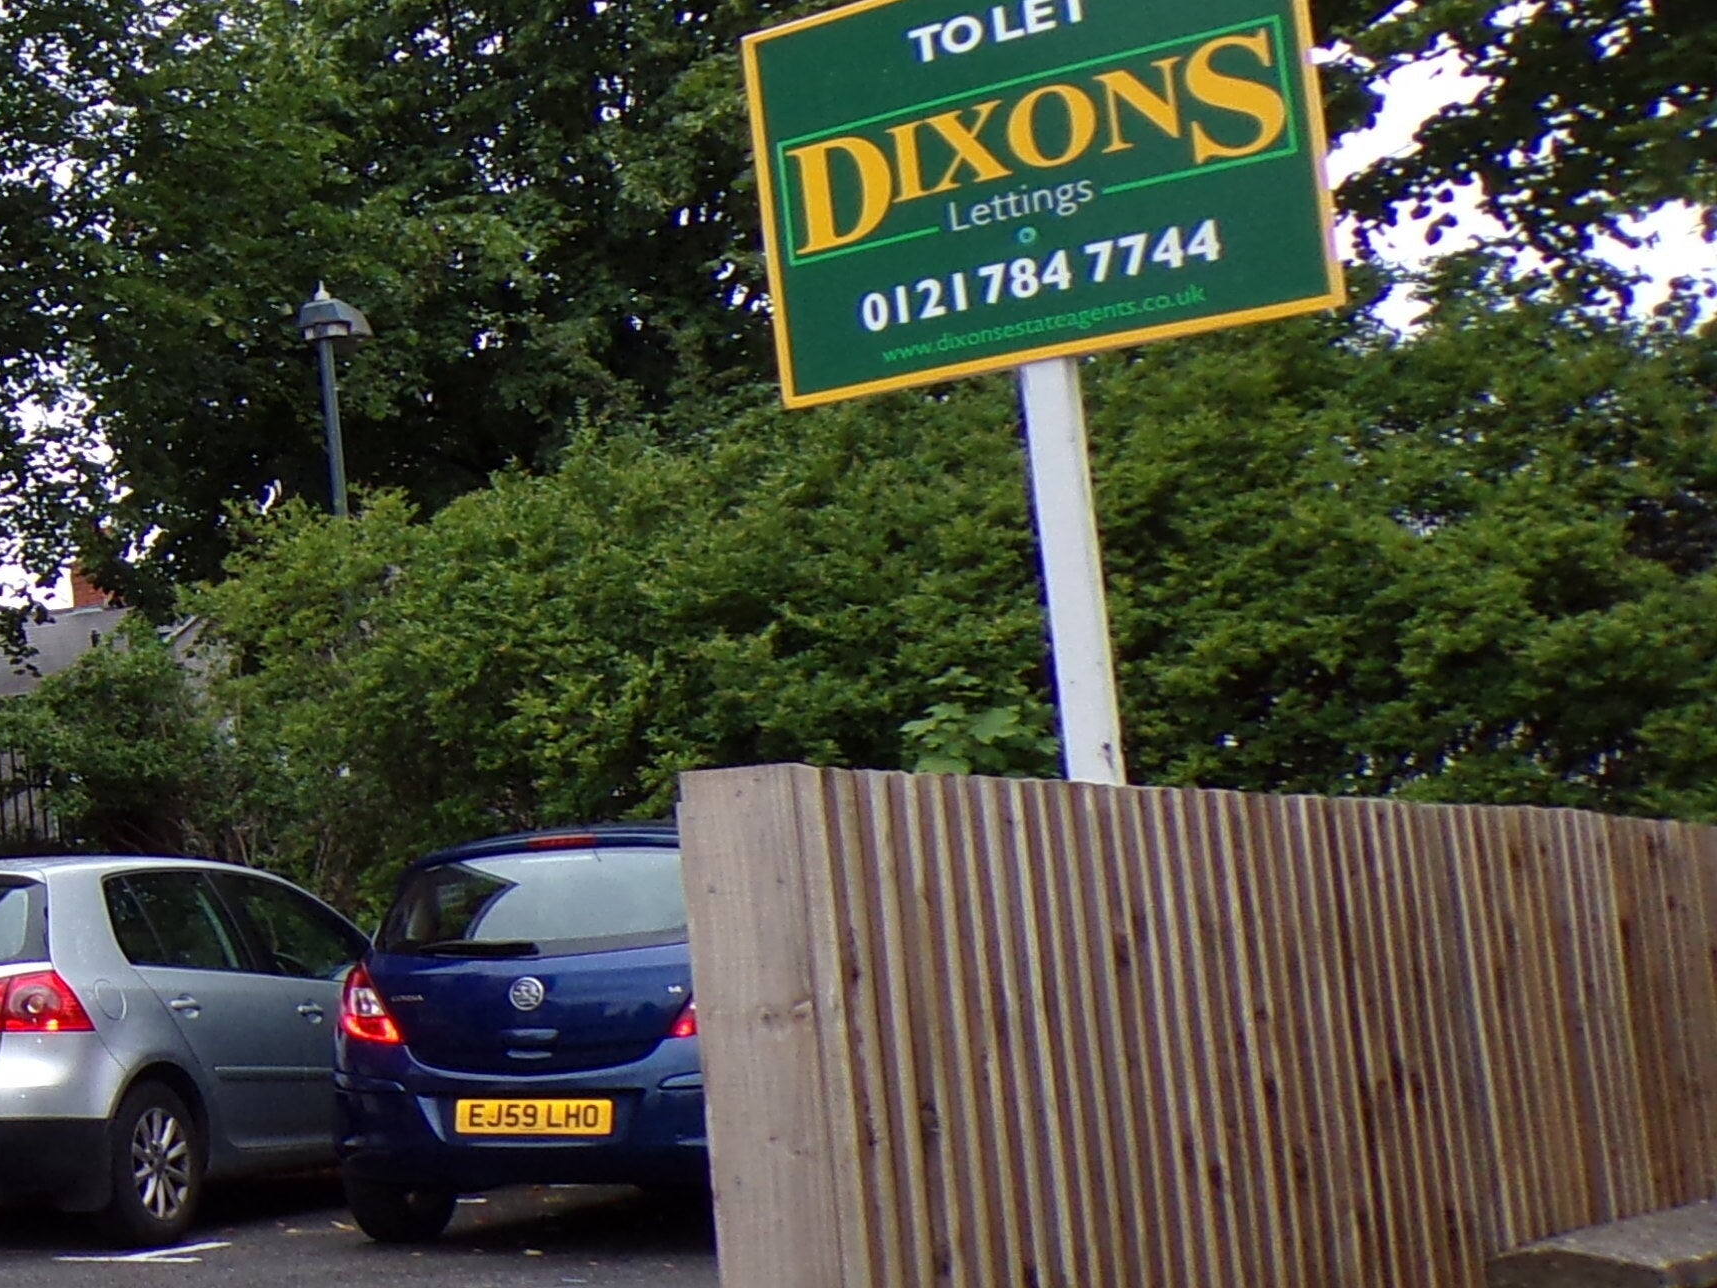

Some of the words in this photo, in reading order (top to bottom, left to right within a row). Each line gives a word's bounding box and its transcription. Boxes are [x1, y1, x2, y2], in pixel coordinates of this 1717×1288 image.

[908, 17, 983, 63] TO
[785, 29, 1287, 256] DIXONS
[948, 178, 1093, 232] Lettings
[860, 272, 970, 333] 0121
[978, 255, 1072, 305] 784
[1084, 218, 1222, 283] 7744
[881, 283, 1206, 364] www.dixonsestateagents.co.uk
[468, 1104, 537, 1127] EJ59
